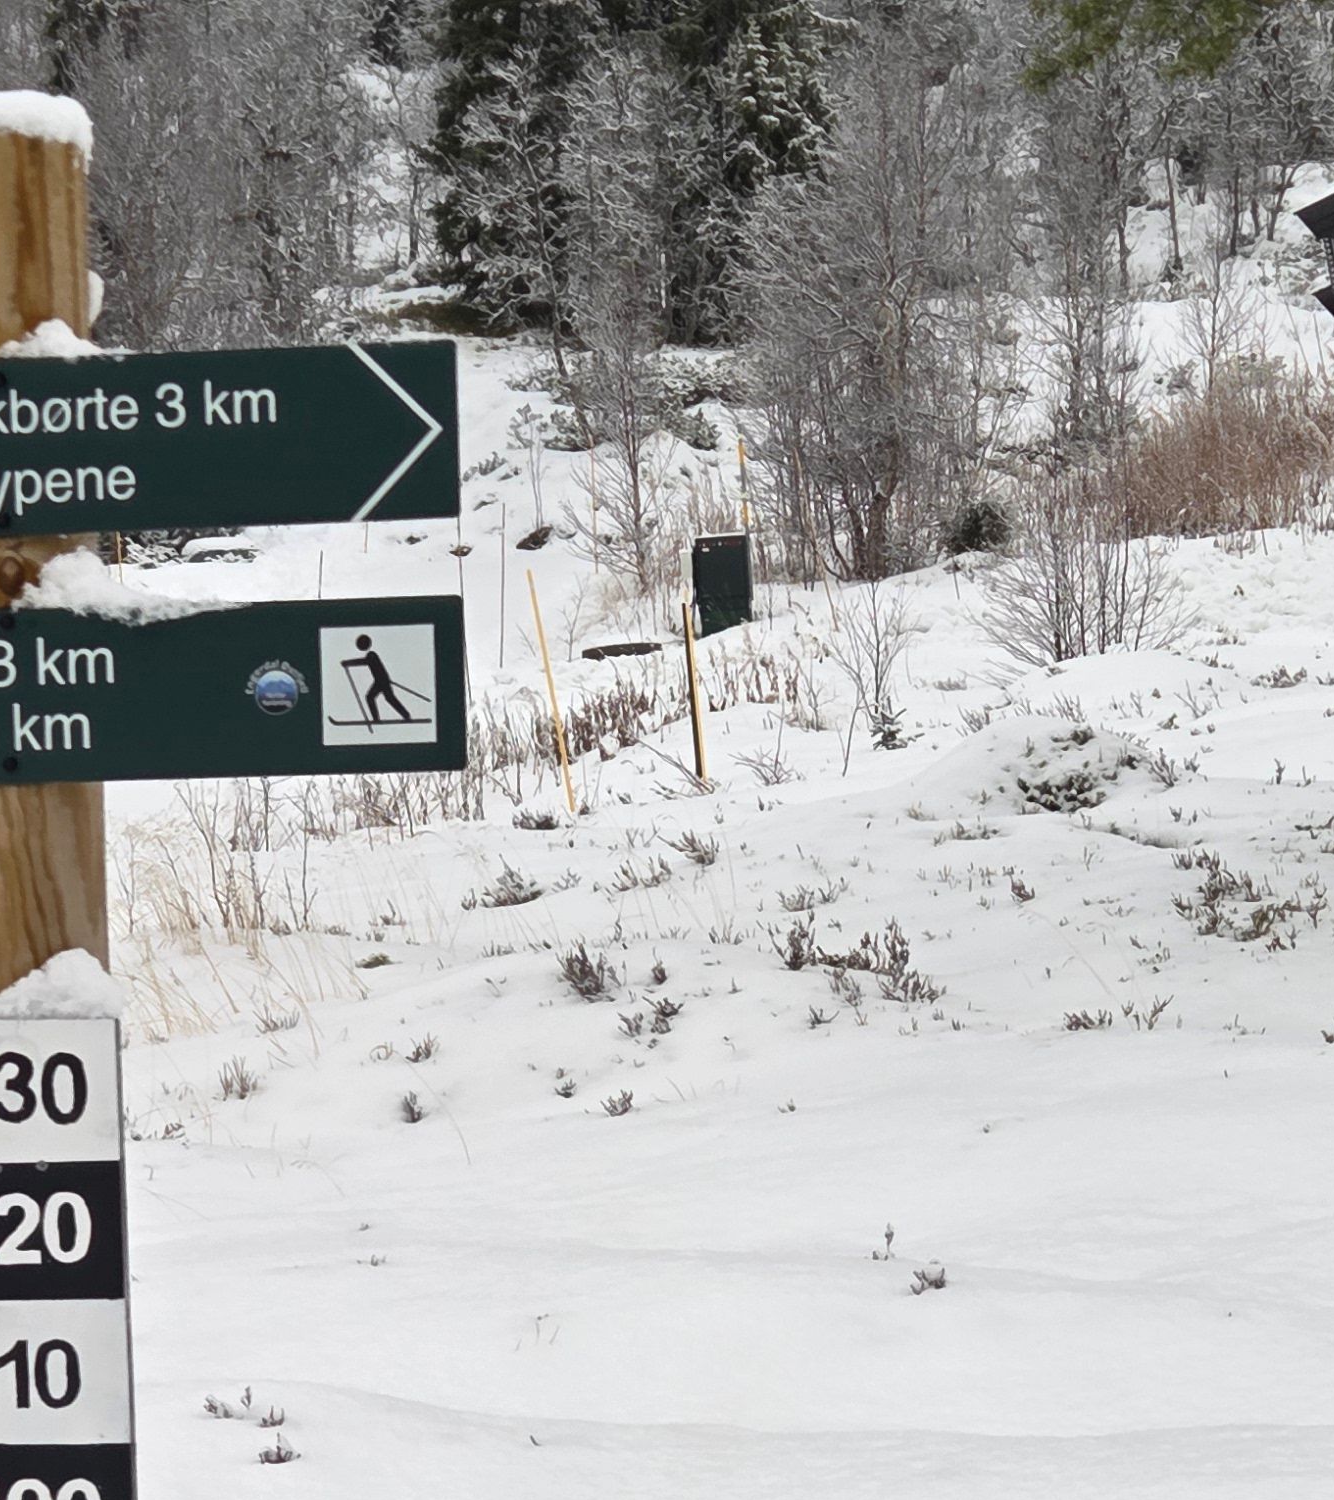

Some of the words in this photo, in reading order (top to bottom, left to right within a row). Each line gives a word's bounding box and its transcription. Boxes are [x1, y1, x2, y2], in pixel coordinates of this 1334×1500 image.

[155, 382, 187, 428] 3
[203, 379, 278, 426] km
[36, 637, 115, 685] km
[11, 703, 92, 752] km
